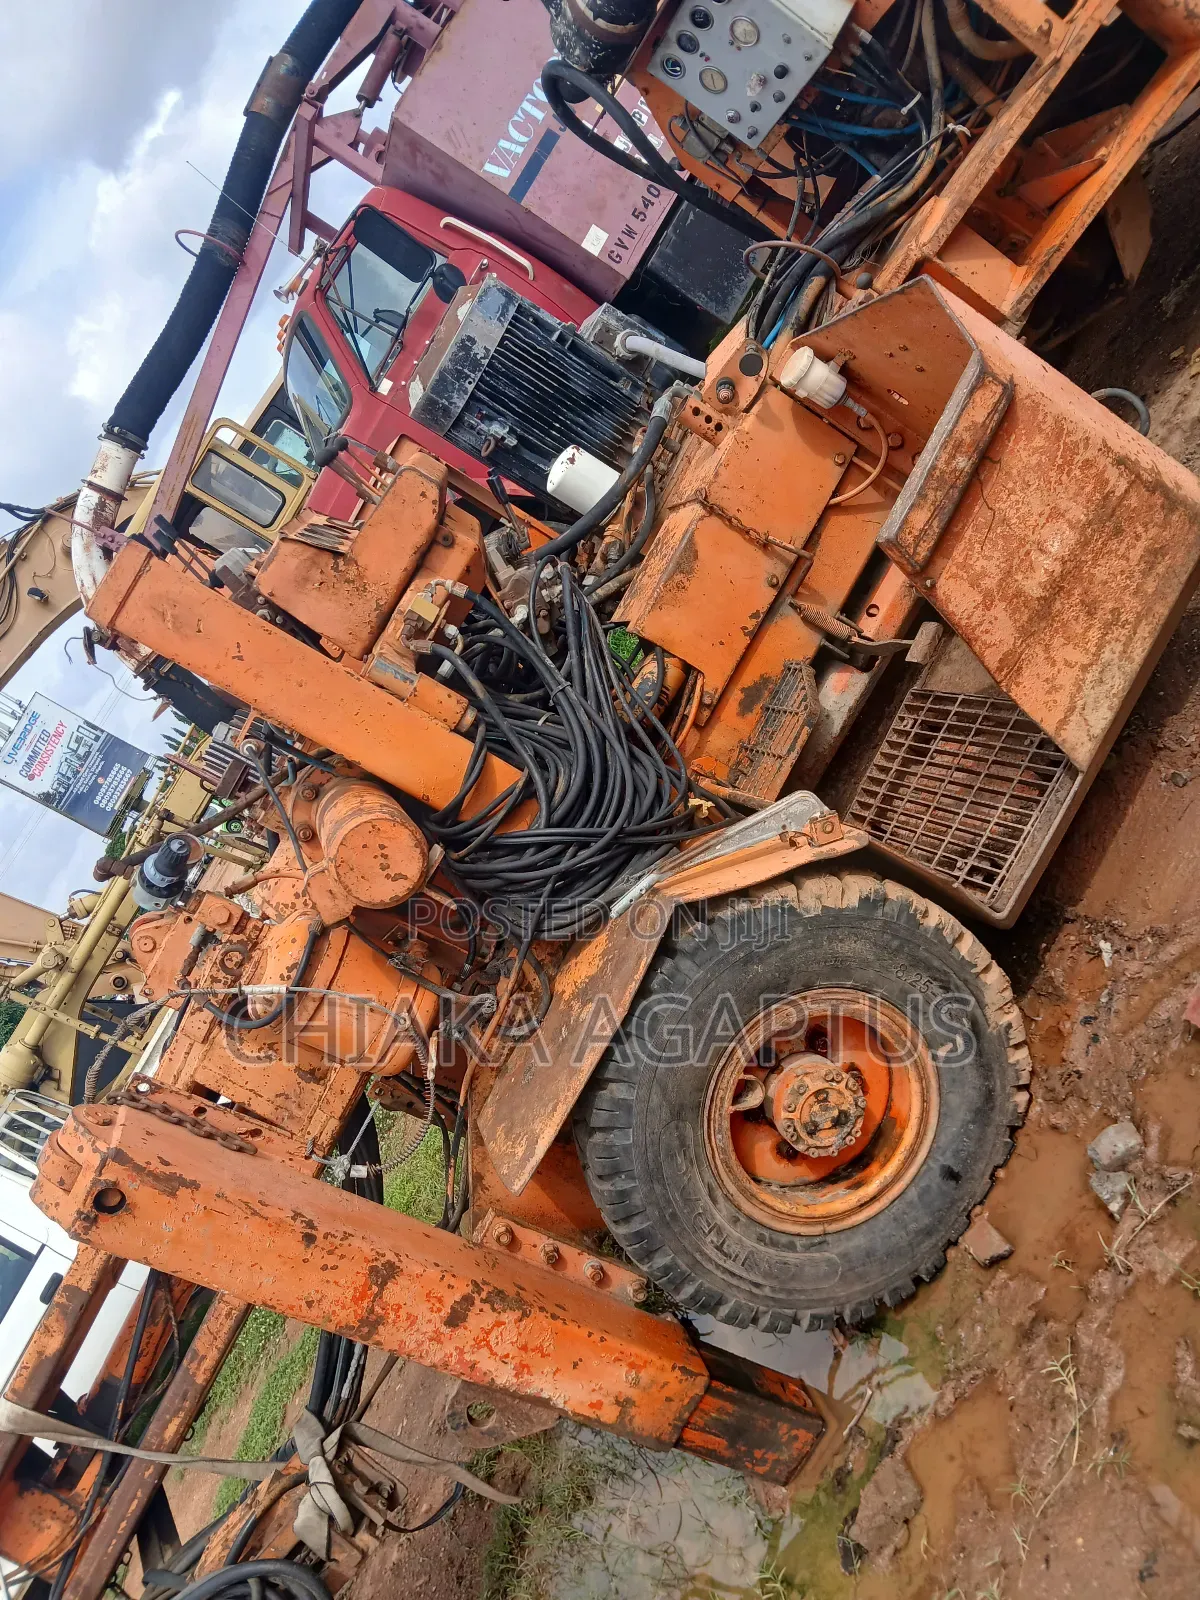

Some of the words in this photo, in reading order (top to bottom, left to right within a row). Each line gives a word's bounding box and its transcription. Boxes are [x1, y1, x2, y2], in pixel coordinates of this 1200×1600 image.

[607, 224, 638, 264] GVW
[631, 183, 661, 222] 540
[19, 728, 51, 777] COMMITTED
[32, 720, 67, 777] CONSISTENCY
